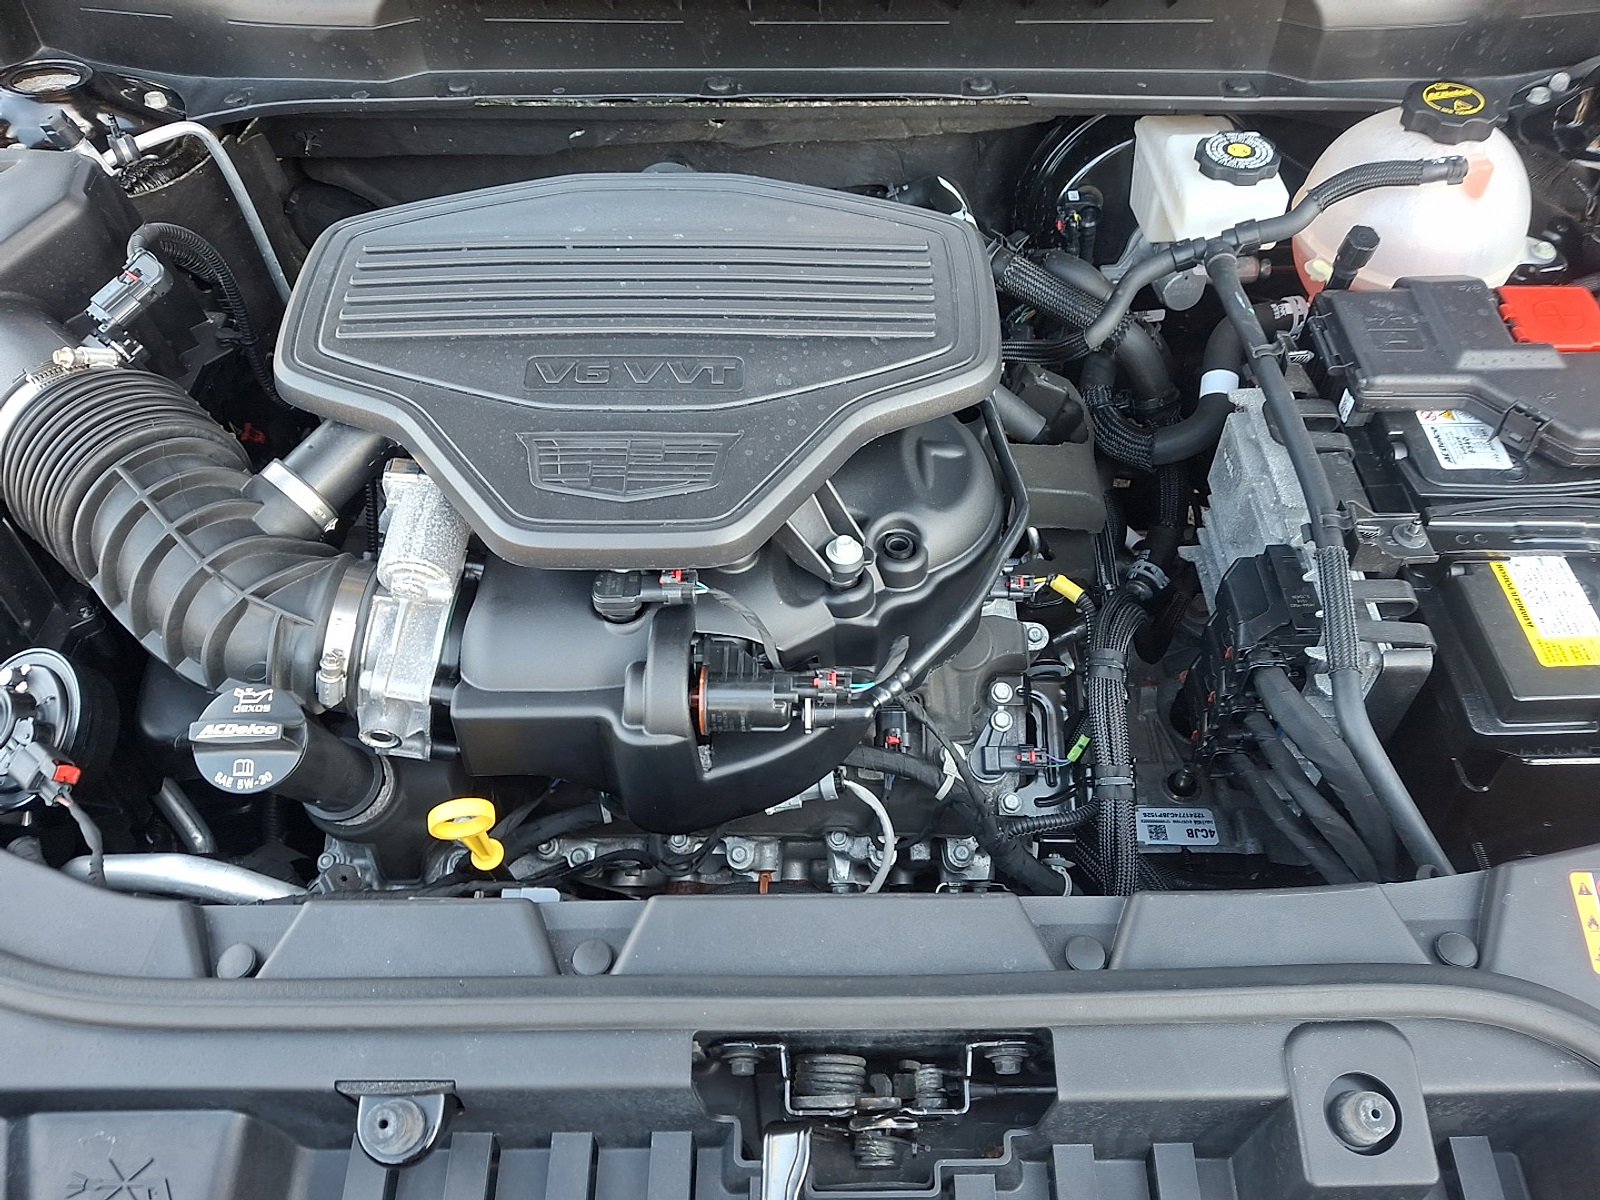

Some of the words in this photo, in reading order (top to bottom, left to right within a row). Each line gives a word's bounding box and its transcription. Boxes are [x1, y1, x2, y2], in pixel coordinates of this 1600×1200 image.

[535, 362, 610, 384] V6
[624, 362, 736, 385] VVT
[232, 703, 271, 713] dexos
[196, 723, 278, 738] ACDelco
[214, 771, 233, 788] SAE
[1186, 828, 1216, 839] 4CJB
